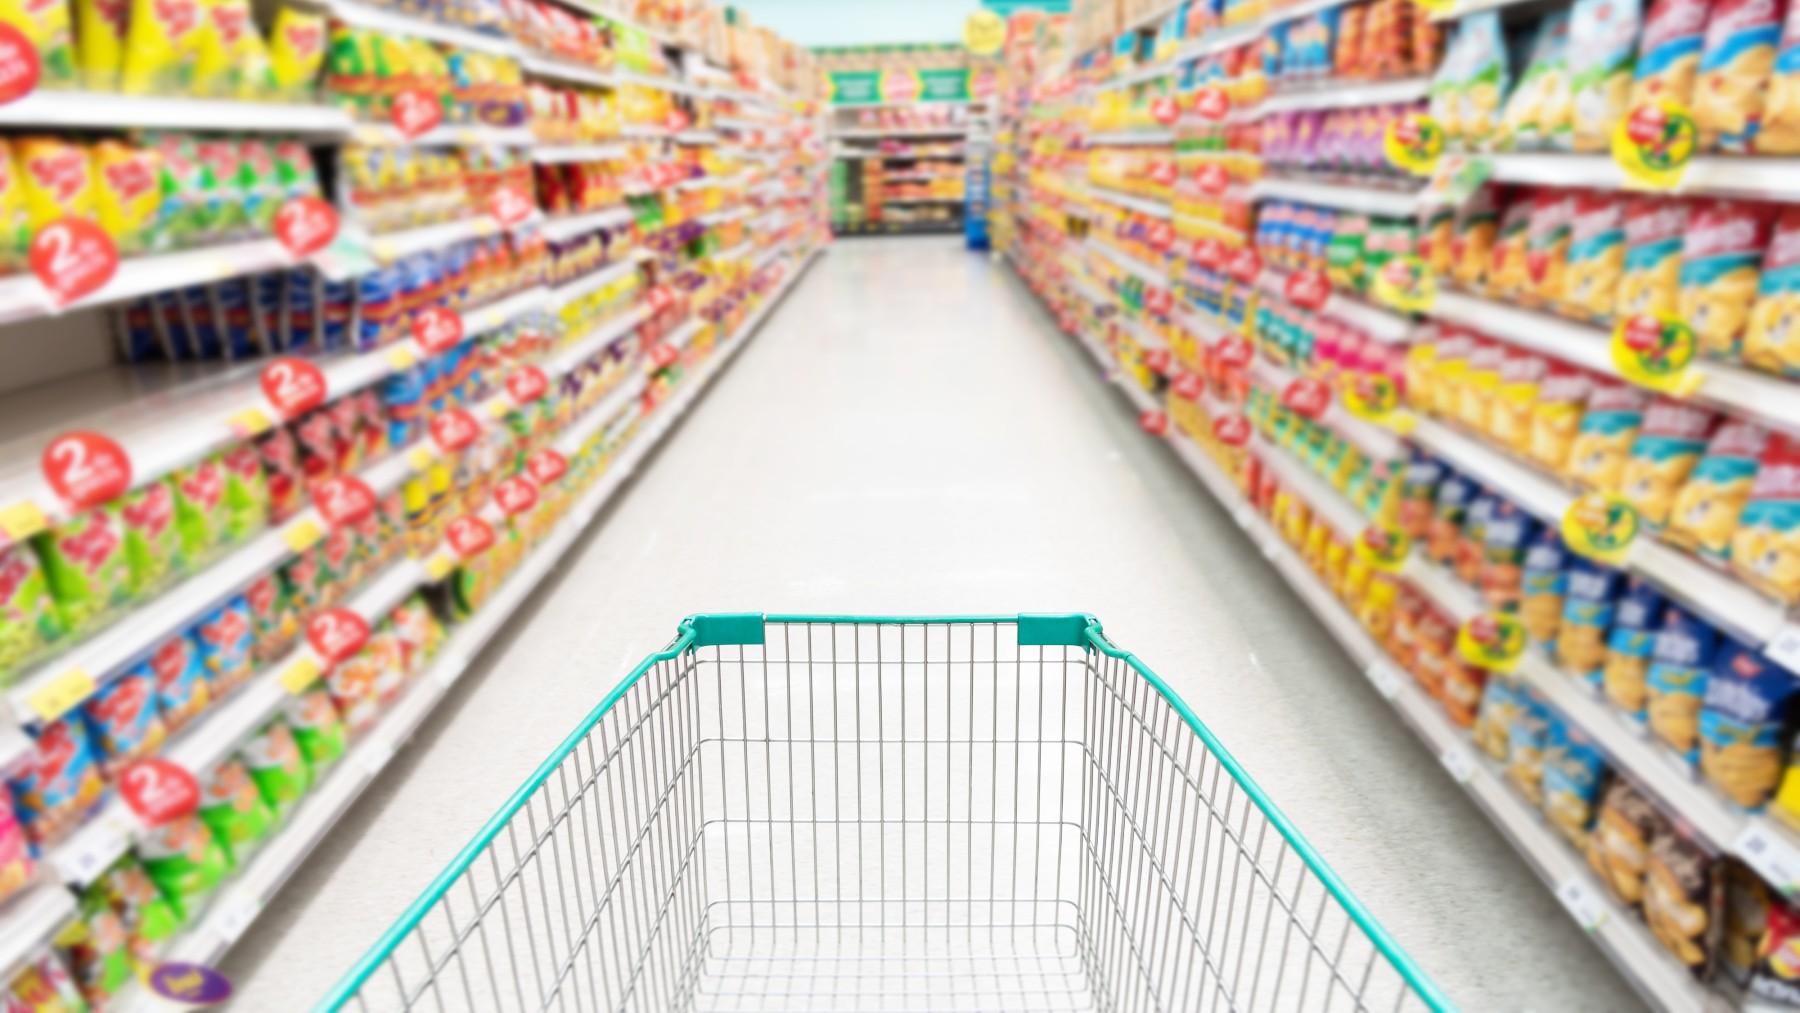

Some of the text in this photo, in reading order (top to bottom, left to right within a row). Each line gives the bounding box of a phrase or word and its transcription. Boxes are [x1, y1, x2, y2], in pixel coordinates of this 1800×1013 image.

[38, 226, 79, 273] 2
[417, 309, 441, 337] 2
[268, 363, 297, 395] 2
[52, 440, 93, 482] 2
[322, 479, 350, 510] 2
[312, 614, 341, 647] 2
[129, 765, 163, 802] 2
